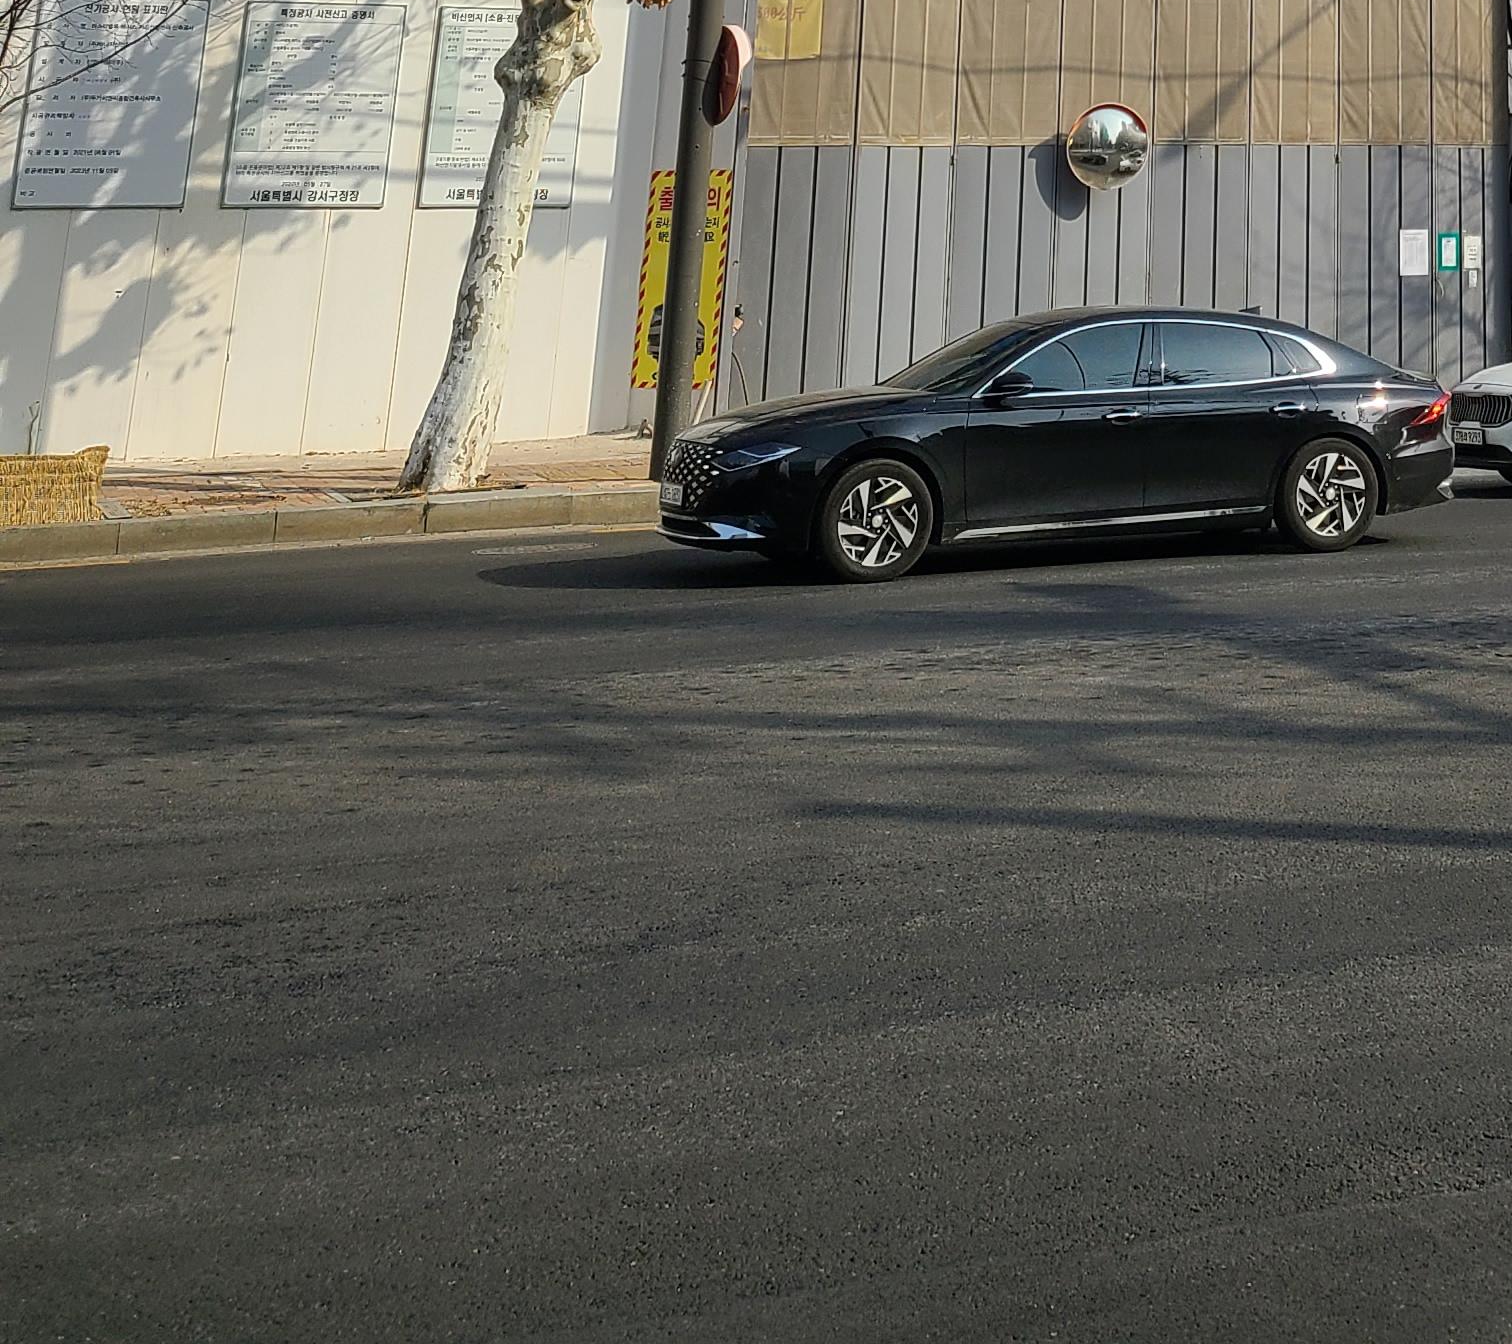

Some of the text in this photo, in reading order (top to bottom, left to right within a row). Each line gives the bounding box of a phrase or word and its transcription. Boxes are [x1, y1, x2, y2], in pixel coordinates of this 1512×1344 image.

[280, 8, 313, 18] 특정공사
[315, 9, 348, 19] 사전신고
[249, 190, 303, 202] 서울특별시
